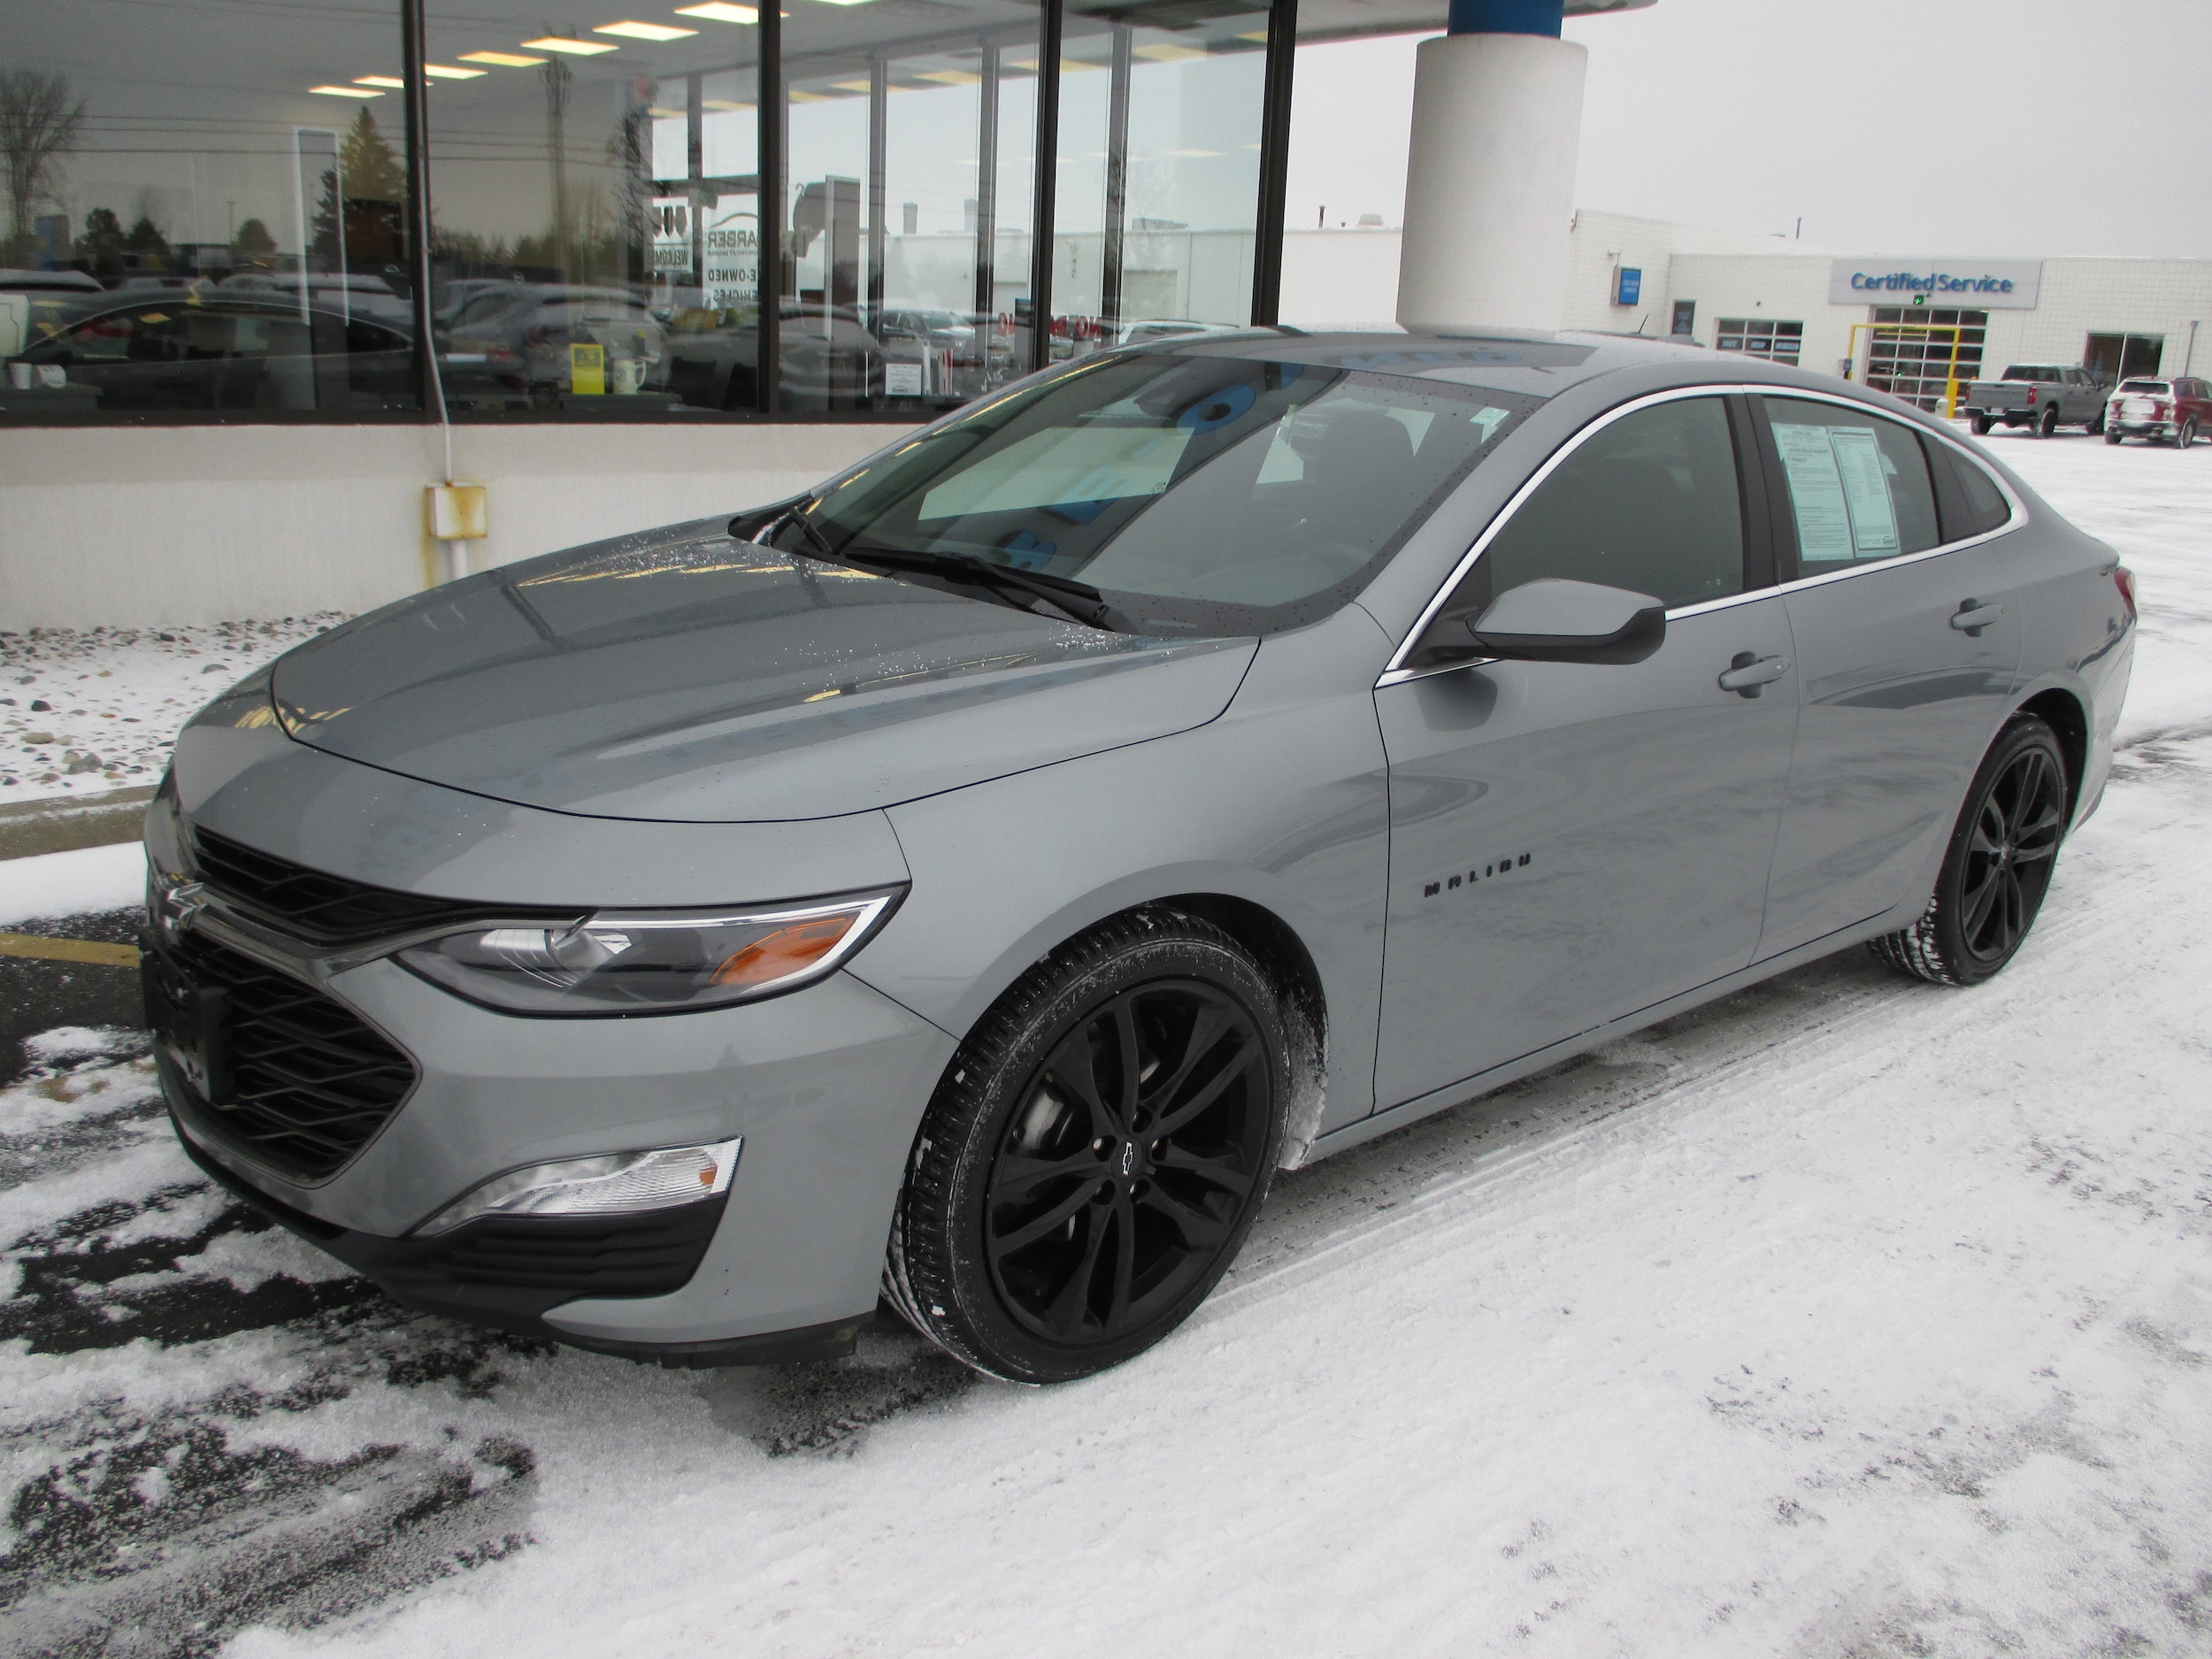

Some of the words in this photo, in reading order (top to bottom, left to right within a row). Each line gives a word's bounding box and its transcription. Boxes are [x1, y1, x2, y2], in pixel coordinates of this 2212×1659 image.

[1851, 273, 1936, 291] Certified
[1938, 273, 2014, 293] Service
[1424, 852, 1532, 898] MALIBU
